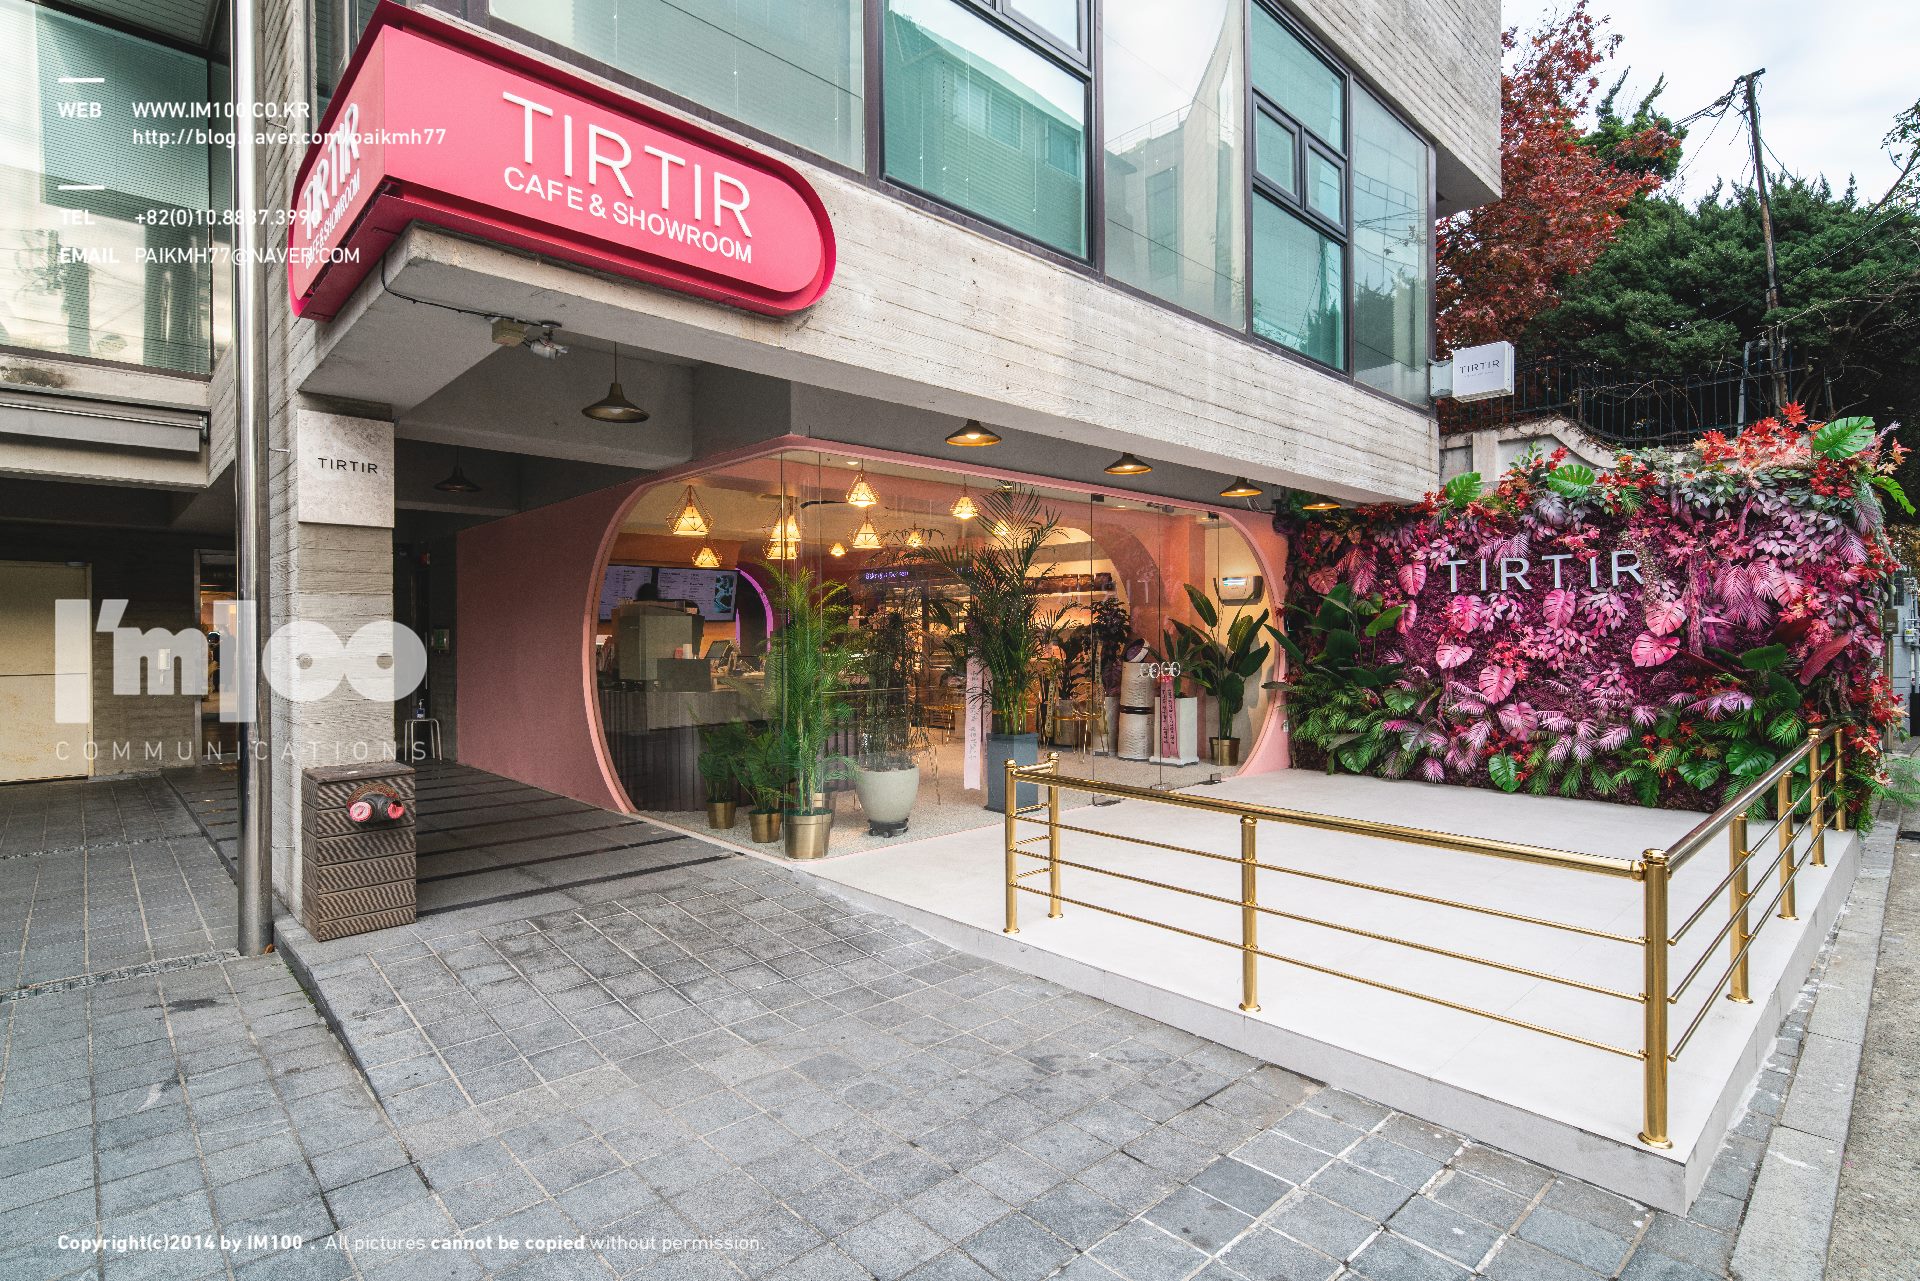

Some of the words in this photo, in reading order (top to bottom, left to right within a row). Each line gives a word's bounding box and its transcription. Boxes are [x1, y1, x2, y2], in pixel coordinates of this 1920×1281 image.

[303, 103, 360, 240] TIRTIR
[502, 91, 752, 238] TIRTIR
[323, 168, 361, 242] SHOWROOM
[503, 166, 584, 212] CAFE
[588, 193, 608, 219] &
[612, 201, 752, 264] SHOWROOM
[1459, 360, 1500, 374] TIRTIR
[317, 457, 378, 475] TIRTIR
[1442, 549, 1645, 593] TIRTIR
